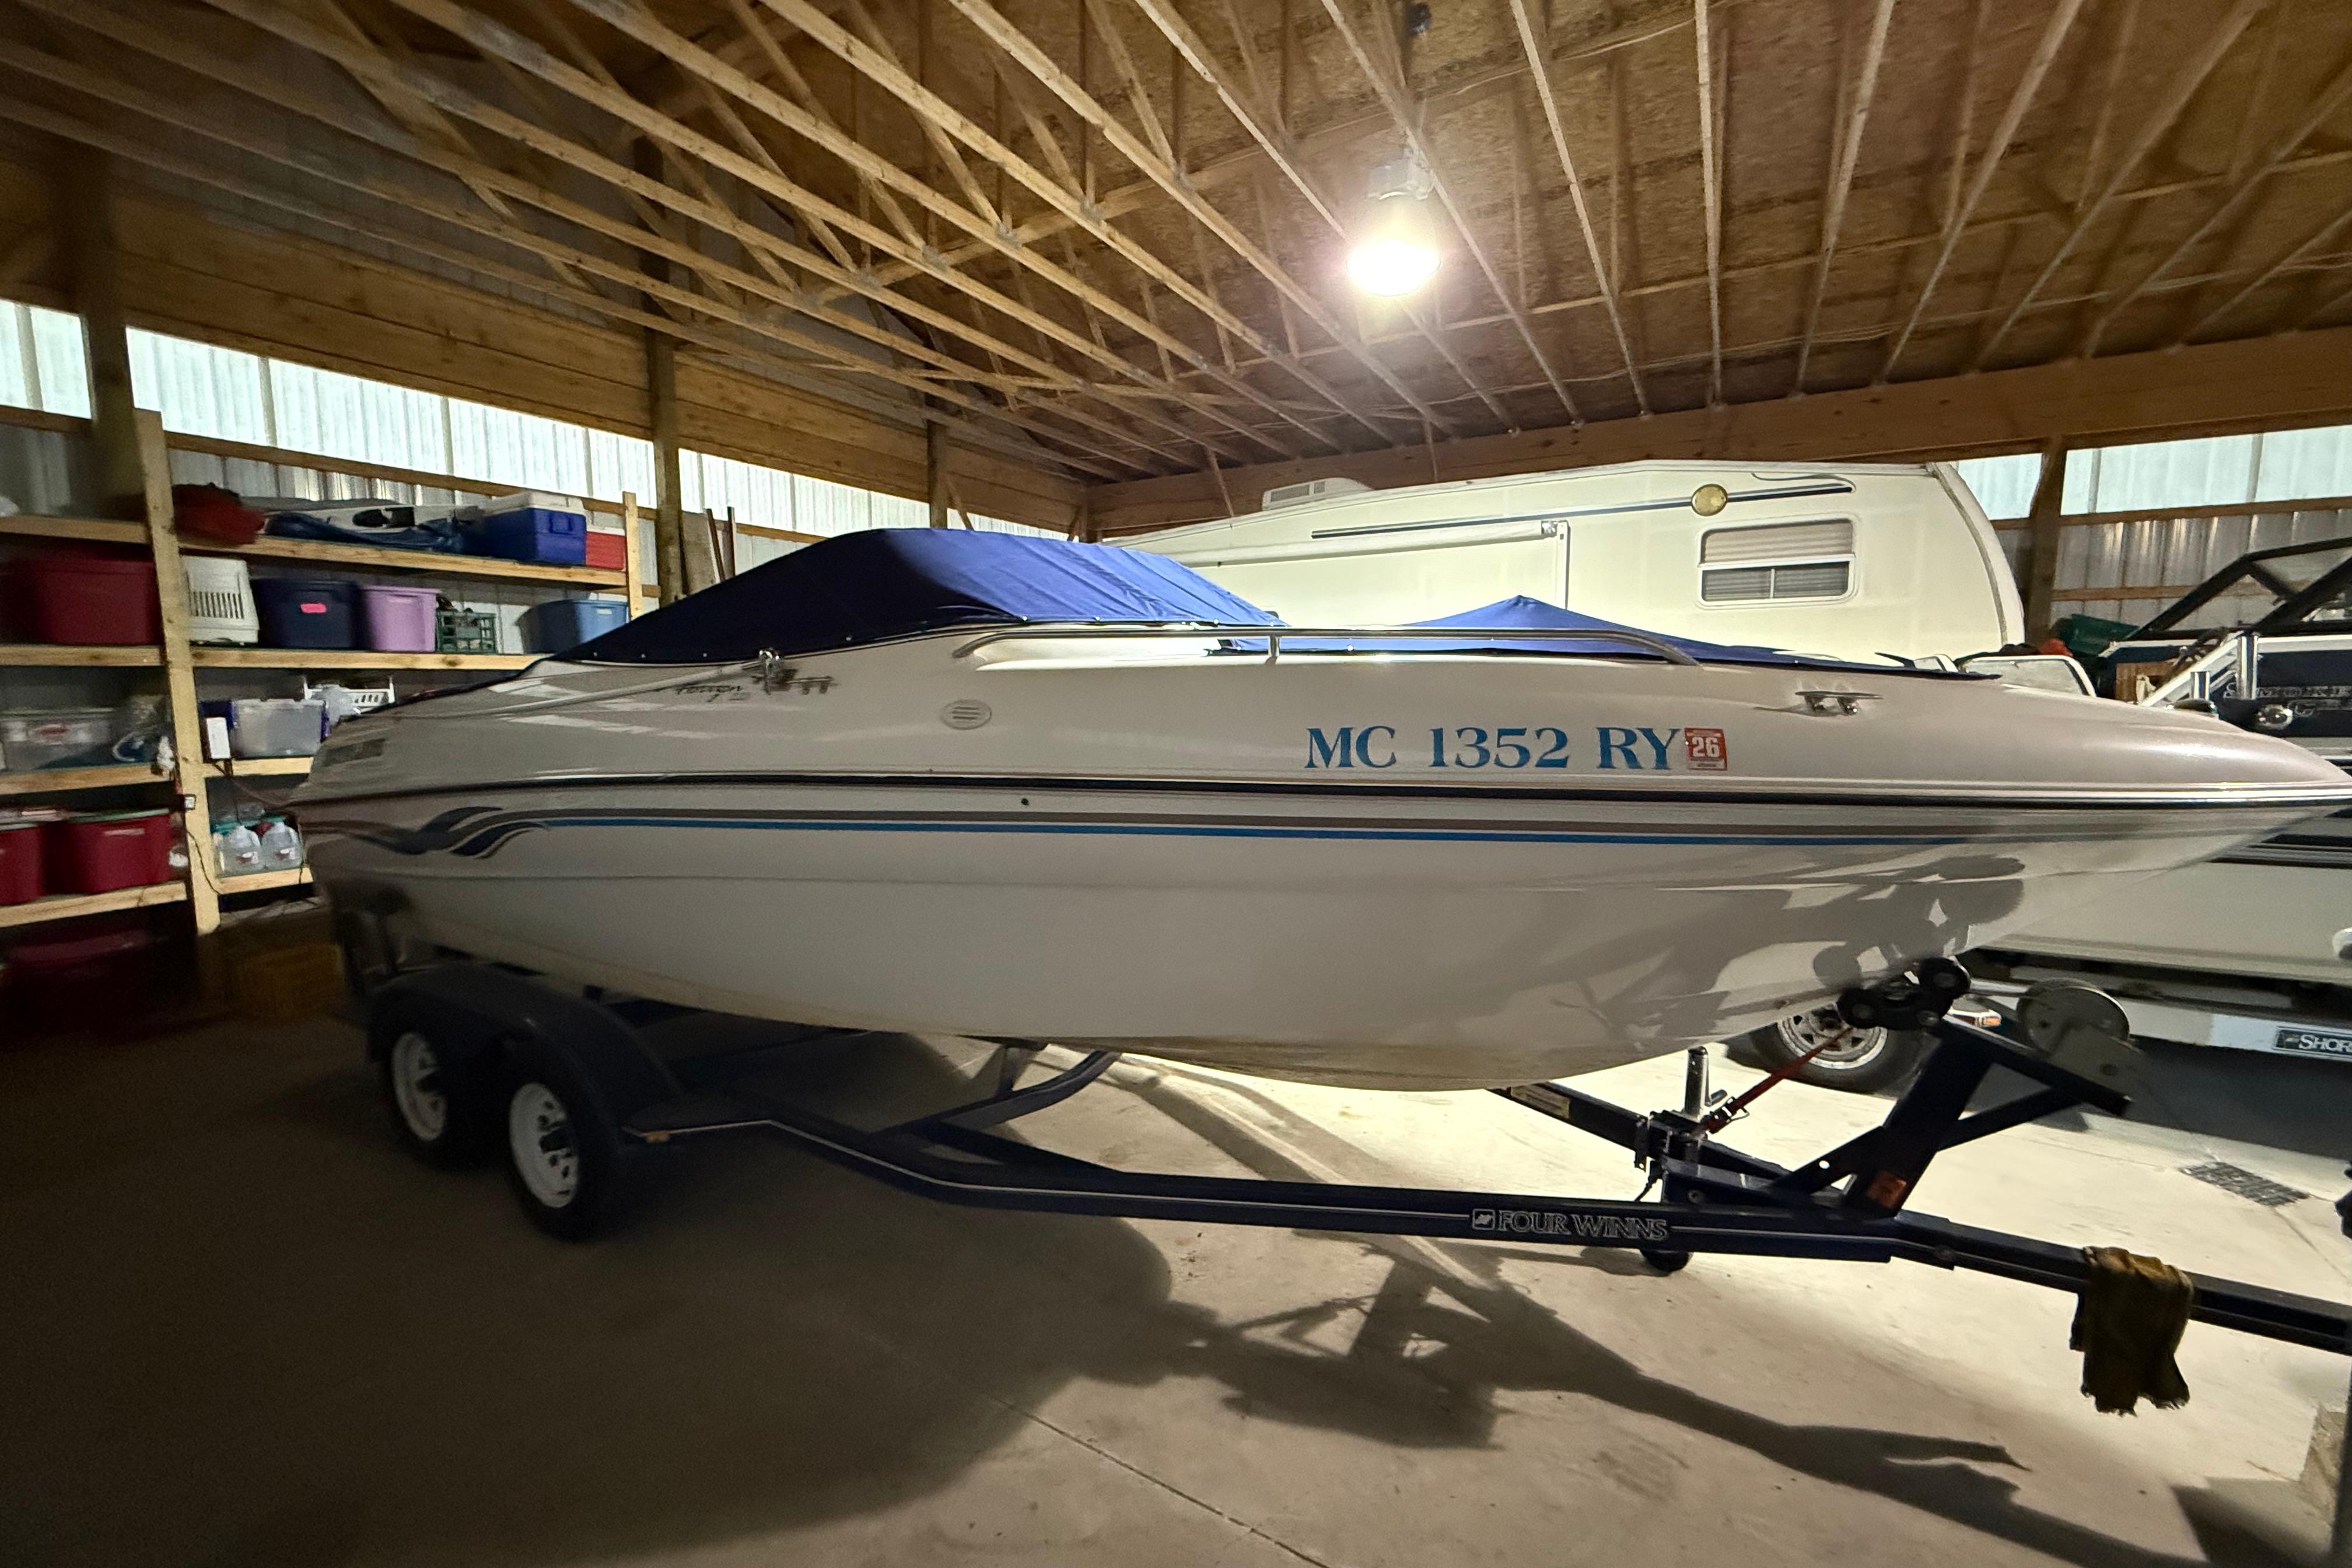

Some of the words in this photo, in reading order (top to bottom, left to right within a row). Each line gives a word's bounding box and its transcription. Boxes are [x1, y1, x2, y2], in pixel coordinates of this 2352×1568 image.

[1304, 725, 1397, 768] MC
[1430, 727, 1569, 769] 1352
[1597, 727, 1681, 770] RY
[1692, 736, 1720, 757] 26
[1498, 1209, 1572, 1236] FOUR
[1572, 1213, 1668, 1241] WINNS
